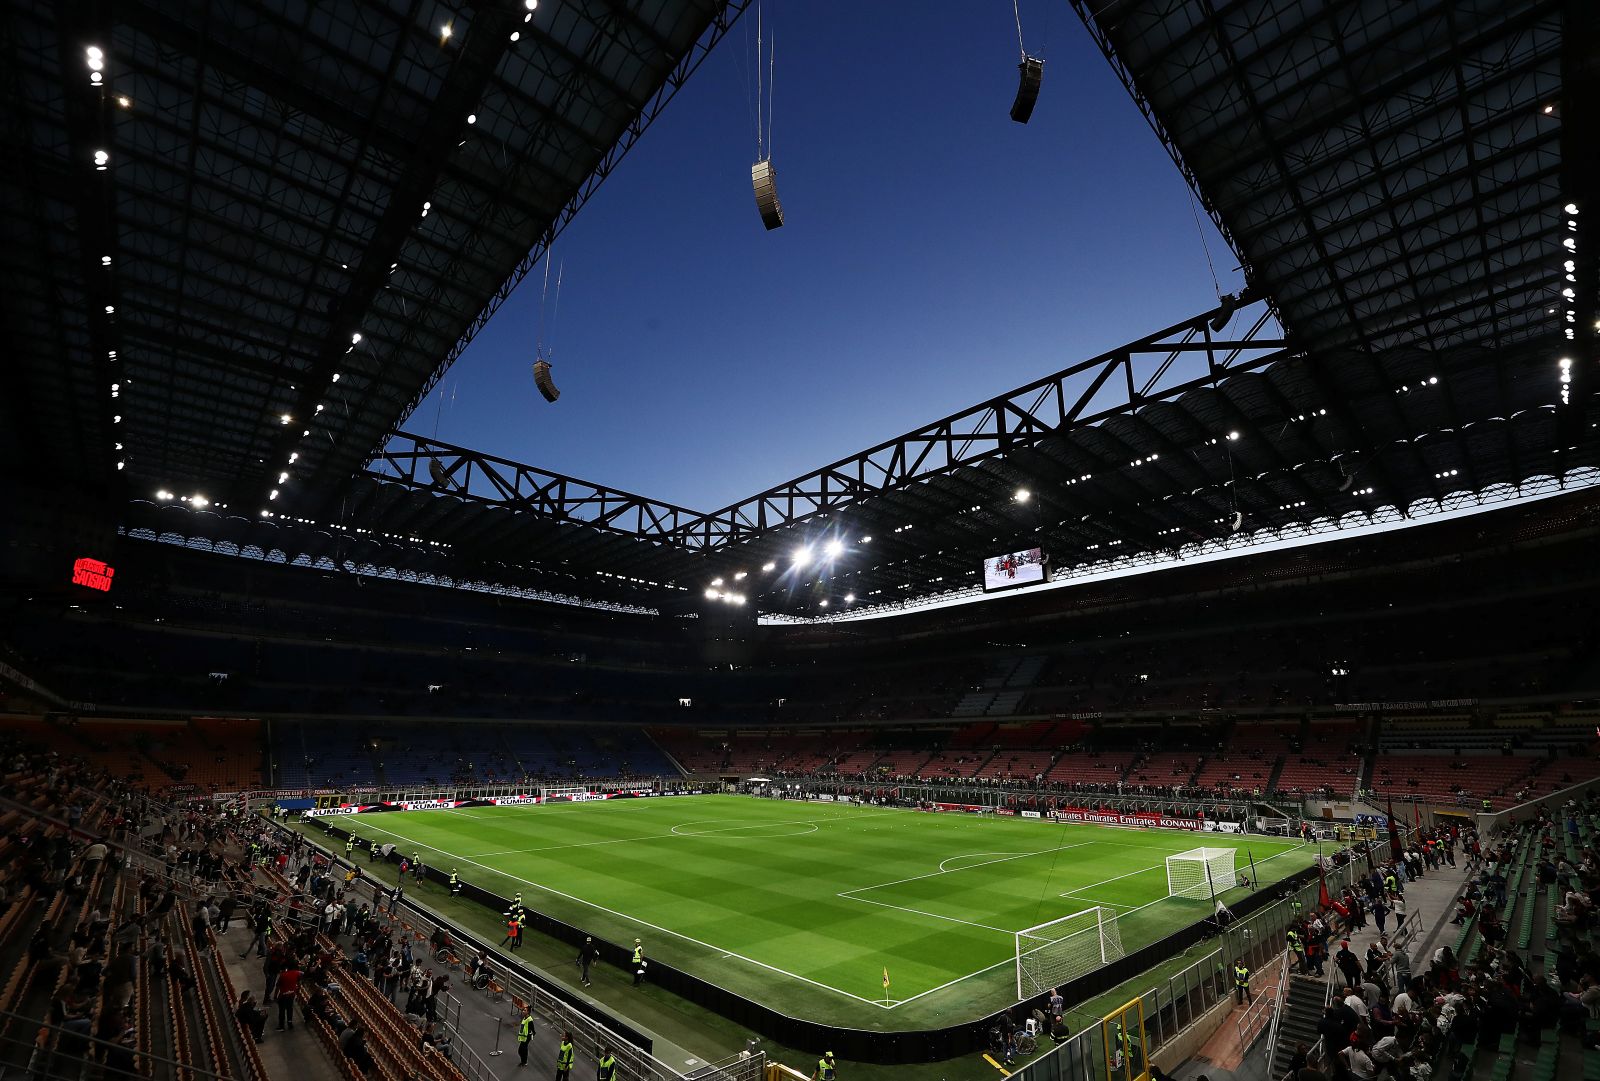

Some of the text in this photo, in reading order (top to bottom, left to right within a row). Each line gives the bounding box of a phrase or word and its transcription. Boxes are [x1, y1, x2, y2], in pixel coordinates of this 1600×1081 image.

[413, 802, 449, 810] KUMHO
[312, 807, 353, 816] KUMHO
[1050, 810, 1157, 826] Emirates Emirates Emirates
[1160, 819, 1197, 829] KONAMI
